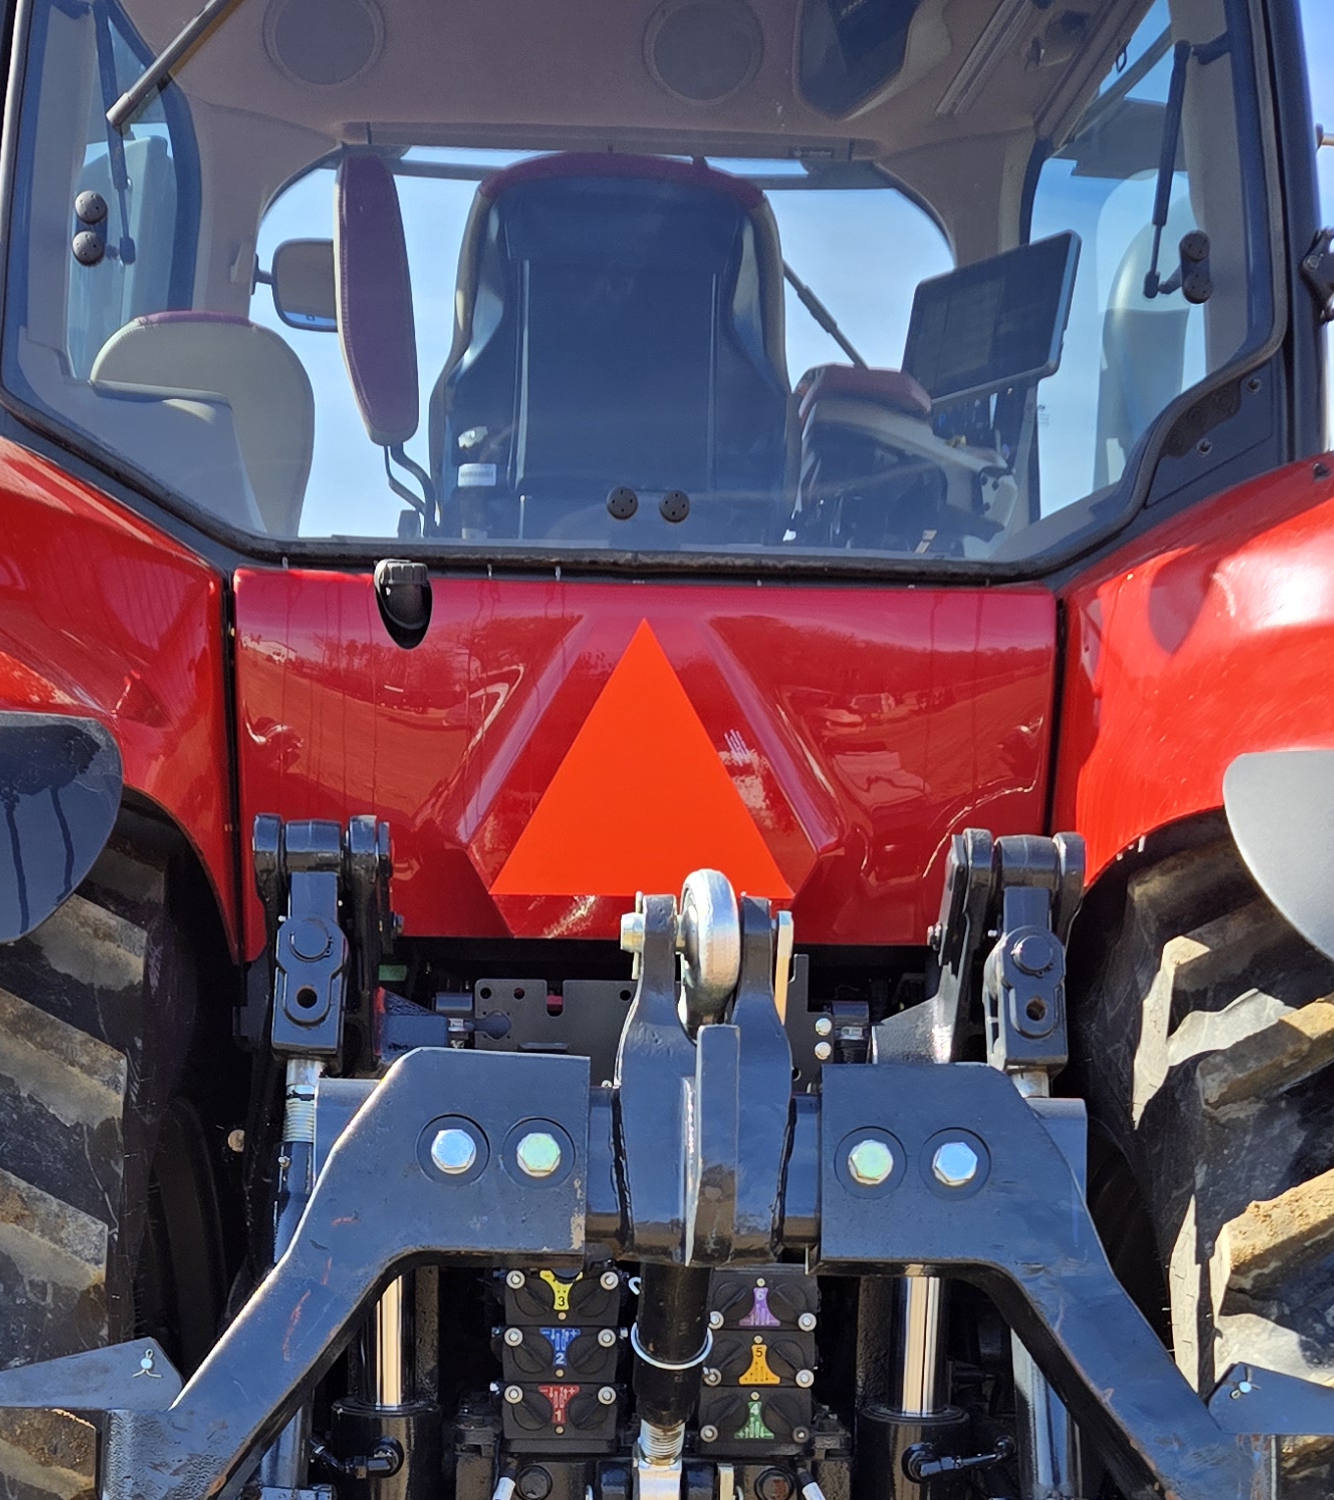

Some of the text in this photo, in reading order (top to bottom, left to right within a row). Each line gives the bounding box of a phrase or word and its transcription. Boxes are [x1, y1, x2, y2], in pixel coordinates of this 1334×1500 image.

[756, 1289, 765, 1301] 6
[558, 1296, 566, 1307] 3
[755, 1347, 763, 1358] 5
[555, 1352, 565, 1365] 2
[750, 1403, 760, 1415] 4
[555, 1410, 562, 1421] 1
